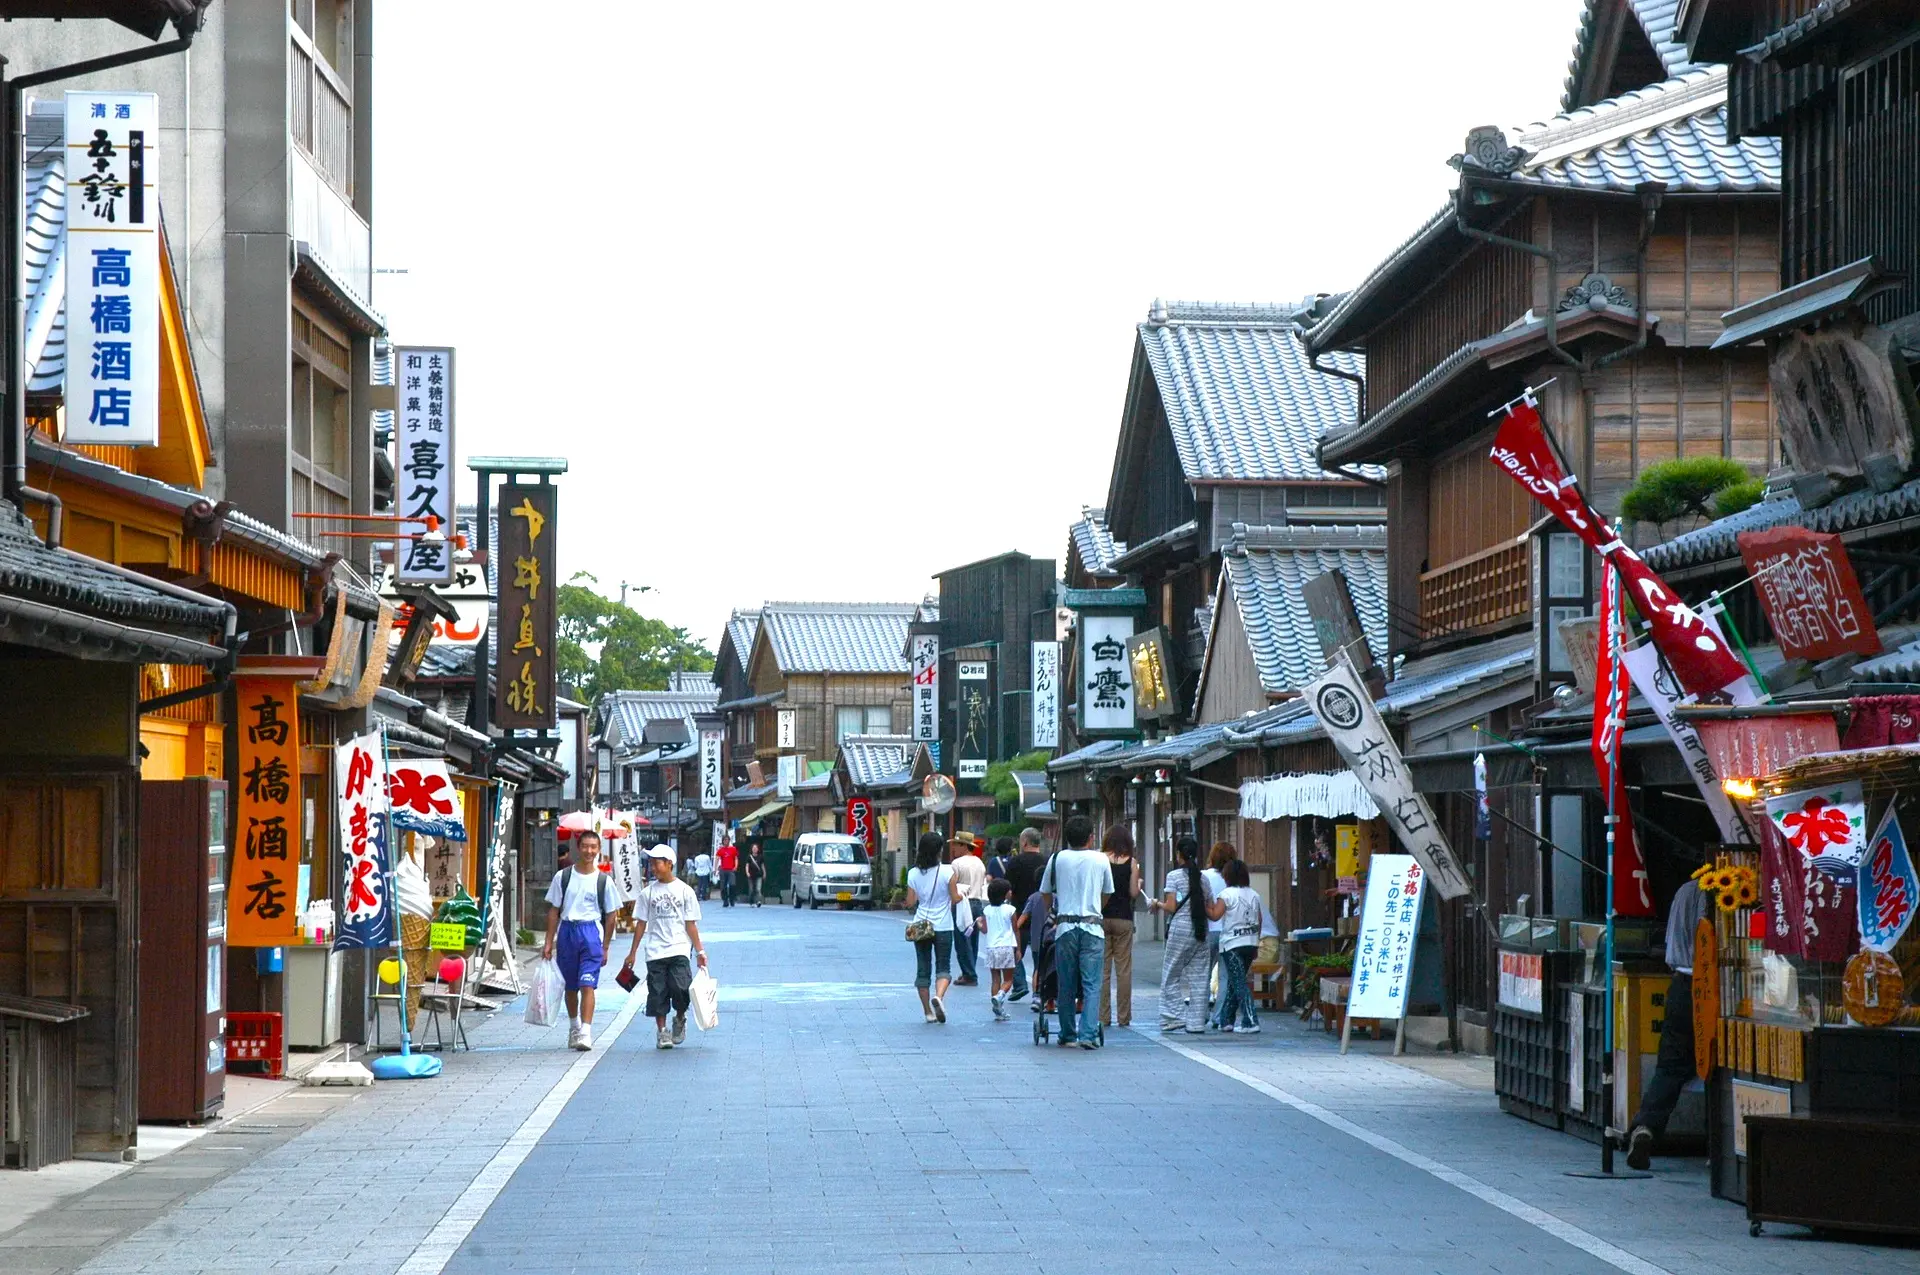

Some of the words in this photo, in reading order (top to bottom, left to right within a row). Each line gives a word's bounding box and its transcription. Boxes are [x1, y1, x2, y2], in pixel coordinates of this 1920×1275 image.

[91, 103, 131, 119] 清酒
[89, 248, 132, 428] 高橋酒店
[406, 354, 422, 432] 和洋菓子
[403, 438, 449, 572] 喜久屋
[1087, 634, 1132, 710] 白鷹
[920, 688, 933, 739] 岡七酒店
[383, 768, 453, 815] 氷
[705, 740, 717, 799] 伊勢うどん
[960, 763, 986, 773] 岡七酒店
[243, 694, 291, 920] 高橋酒店
[345, 747, 377, 914] かき氷
[1782, 796, 1853, 857] 氷
[1357, 928, 1378, 996] ございます
